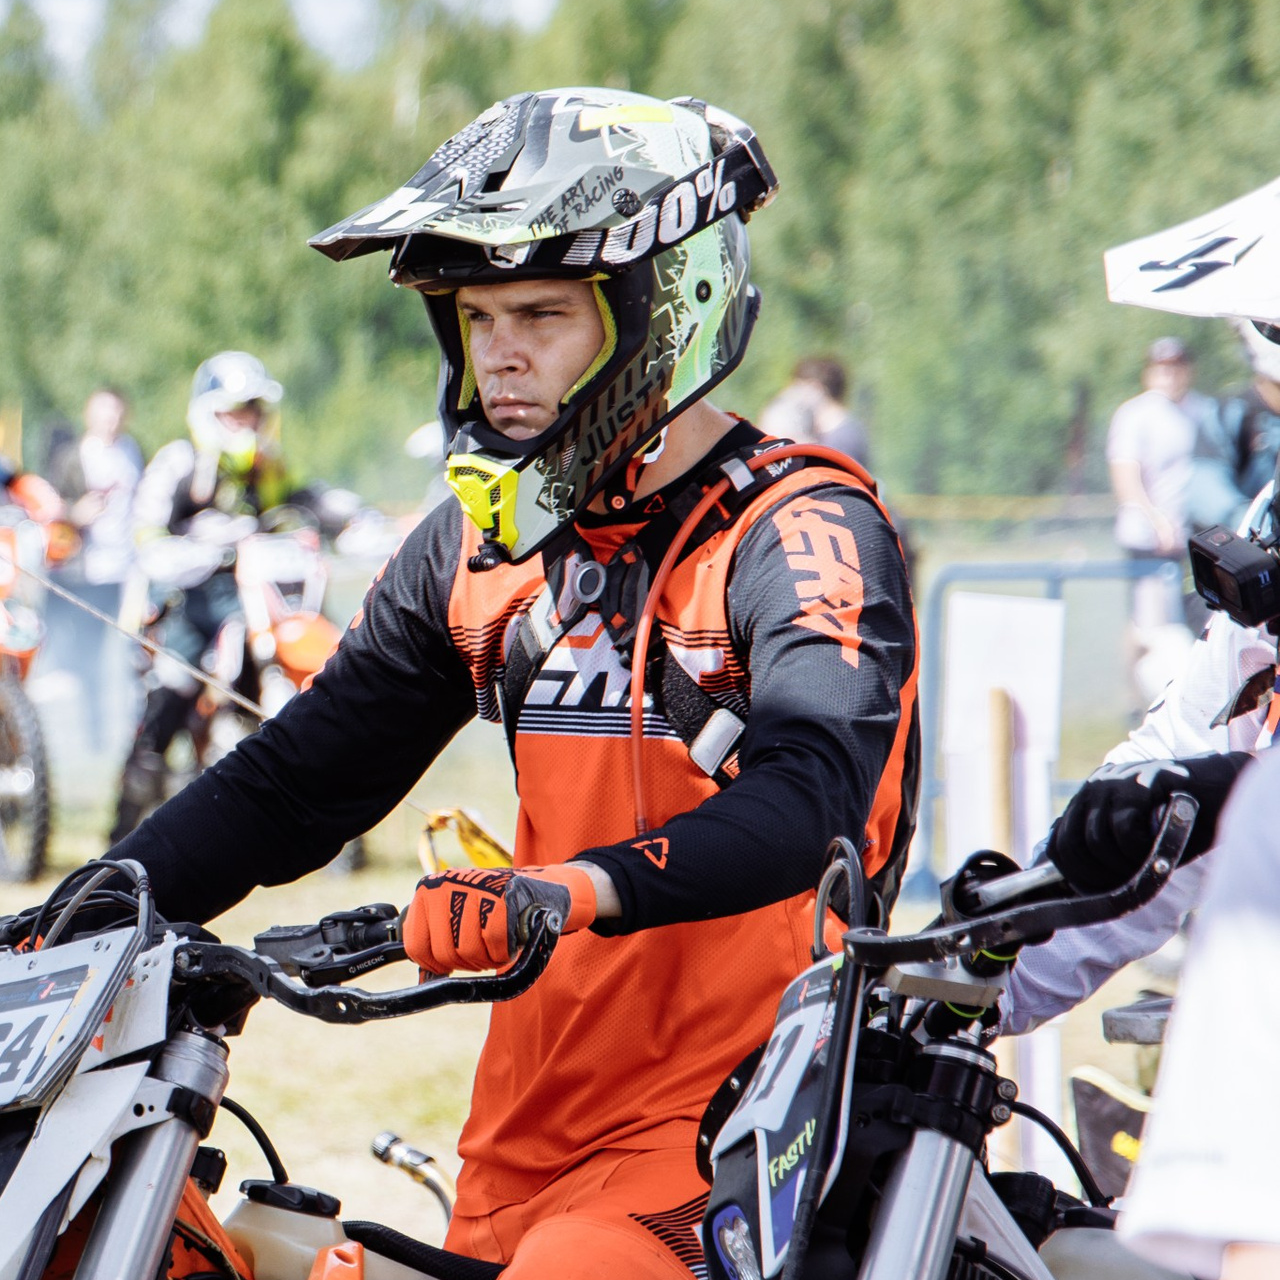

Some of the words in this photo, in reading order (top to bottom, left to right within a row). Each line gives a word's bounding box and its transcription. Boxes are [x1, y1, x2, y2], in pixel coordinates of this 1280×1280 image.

[527, 205, 556, 239] THE
[560, 177, 587, 209] ART
[552, 215, 571, 237] OF
[561, 159, 736, 265] 100%
